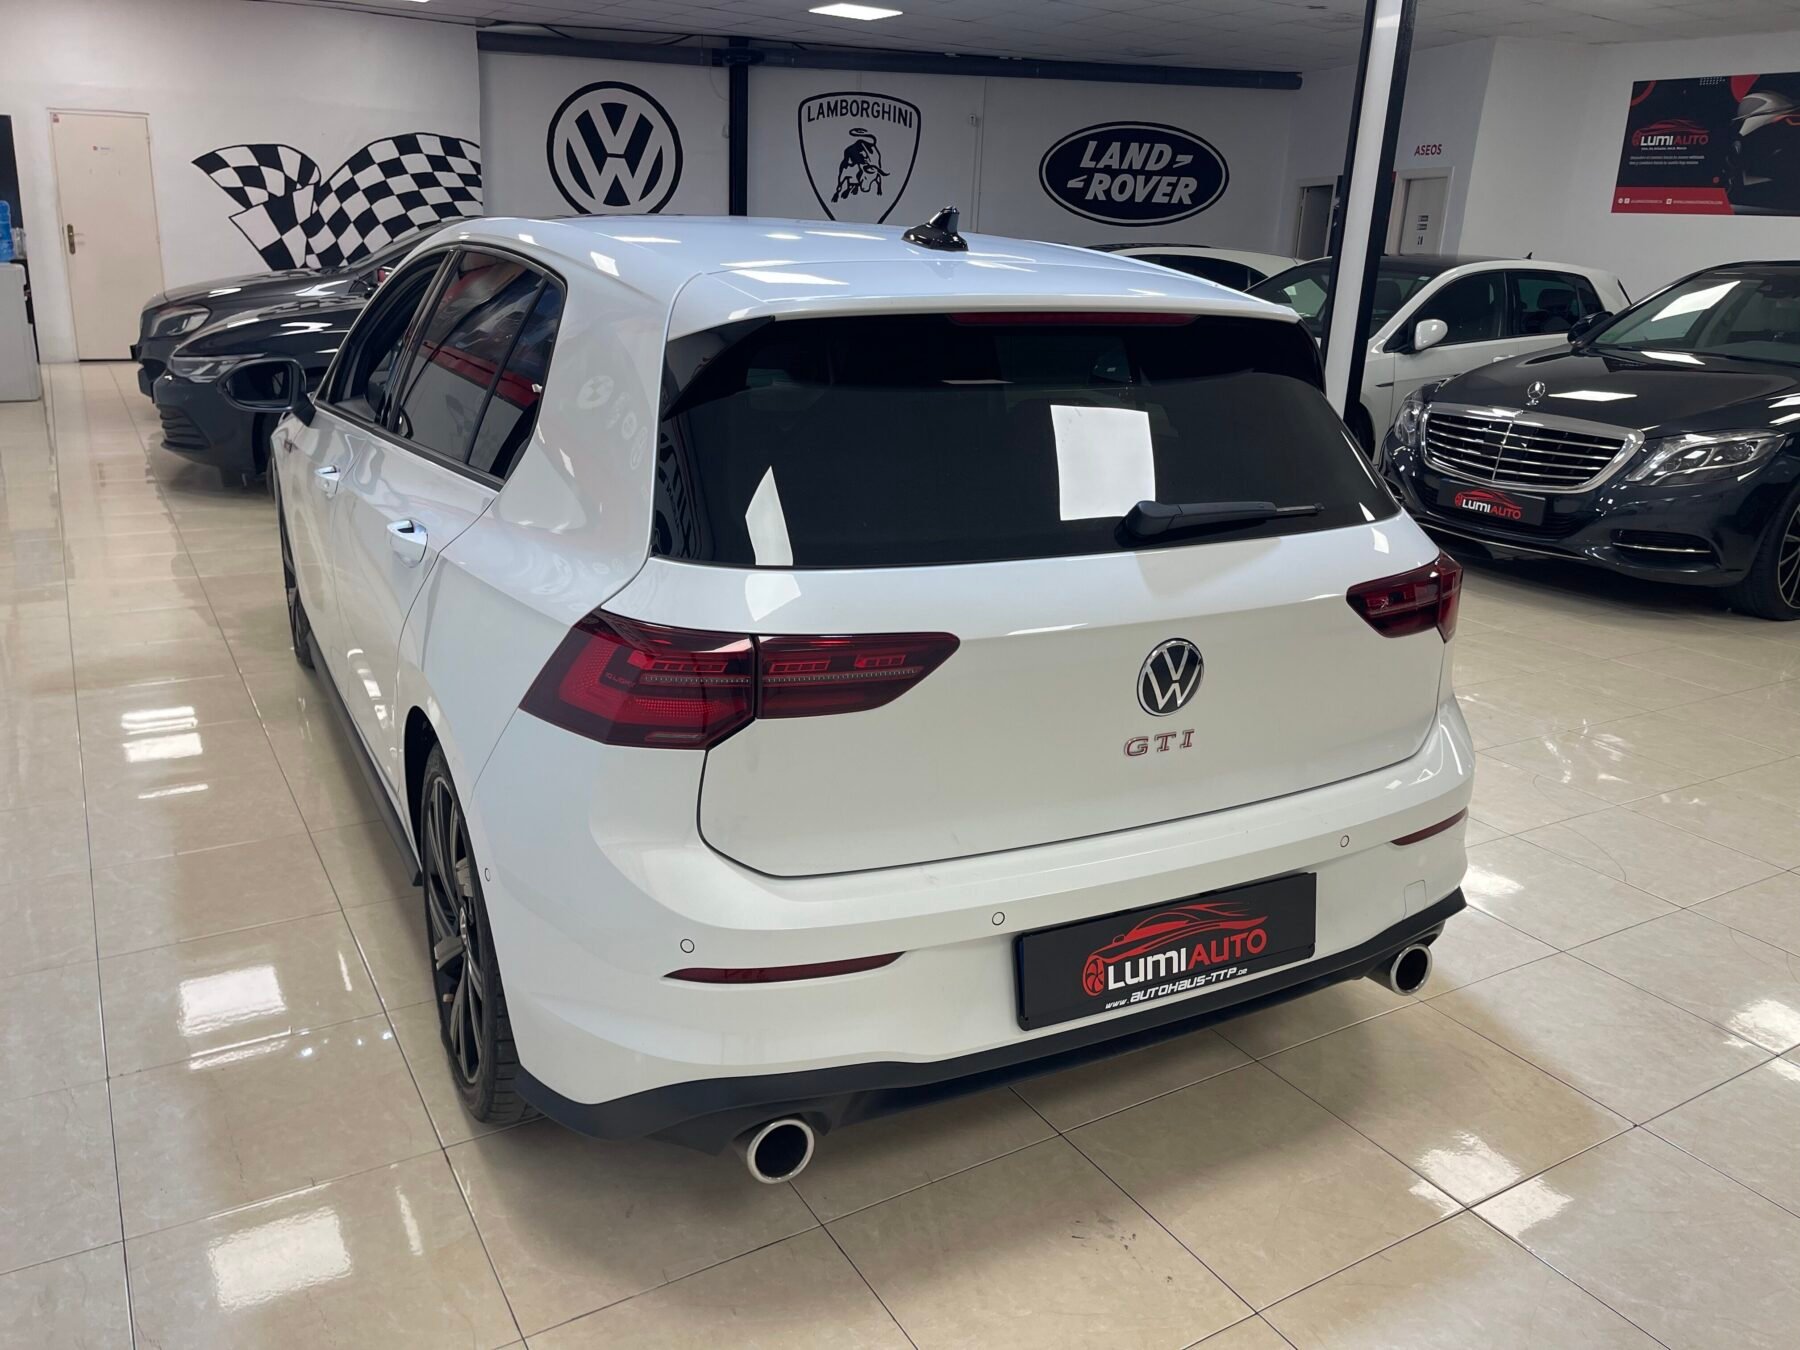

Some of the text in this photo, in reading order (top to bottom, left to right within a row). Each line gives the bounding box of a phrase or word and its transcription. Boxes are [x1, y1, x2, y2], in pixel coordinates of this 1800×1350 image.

[807, 99, 913, 129] LAMBORGHINI
[1080, 140, 1173, 171] LAND
[1414, 144, 1443, 156] ASEOS
[1084, 172, 1198, 205] ROVER
[1124, 728, 1195, 757] GTI
